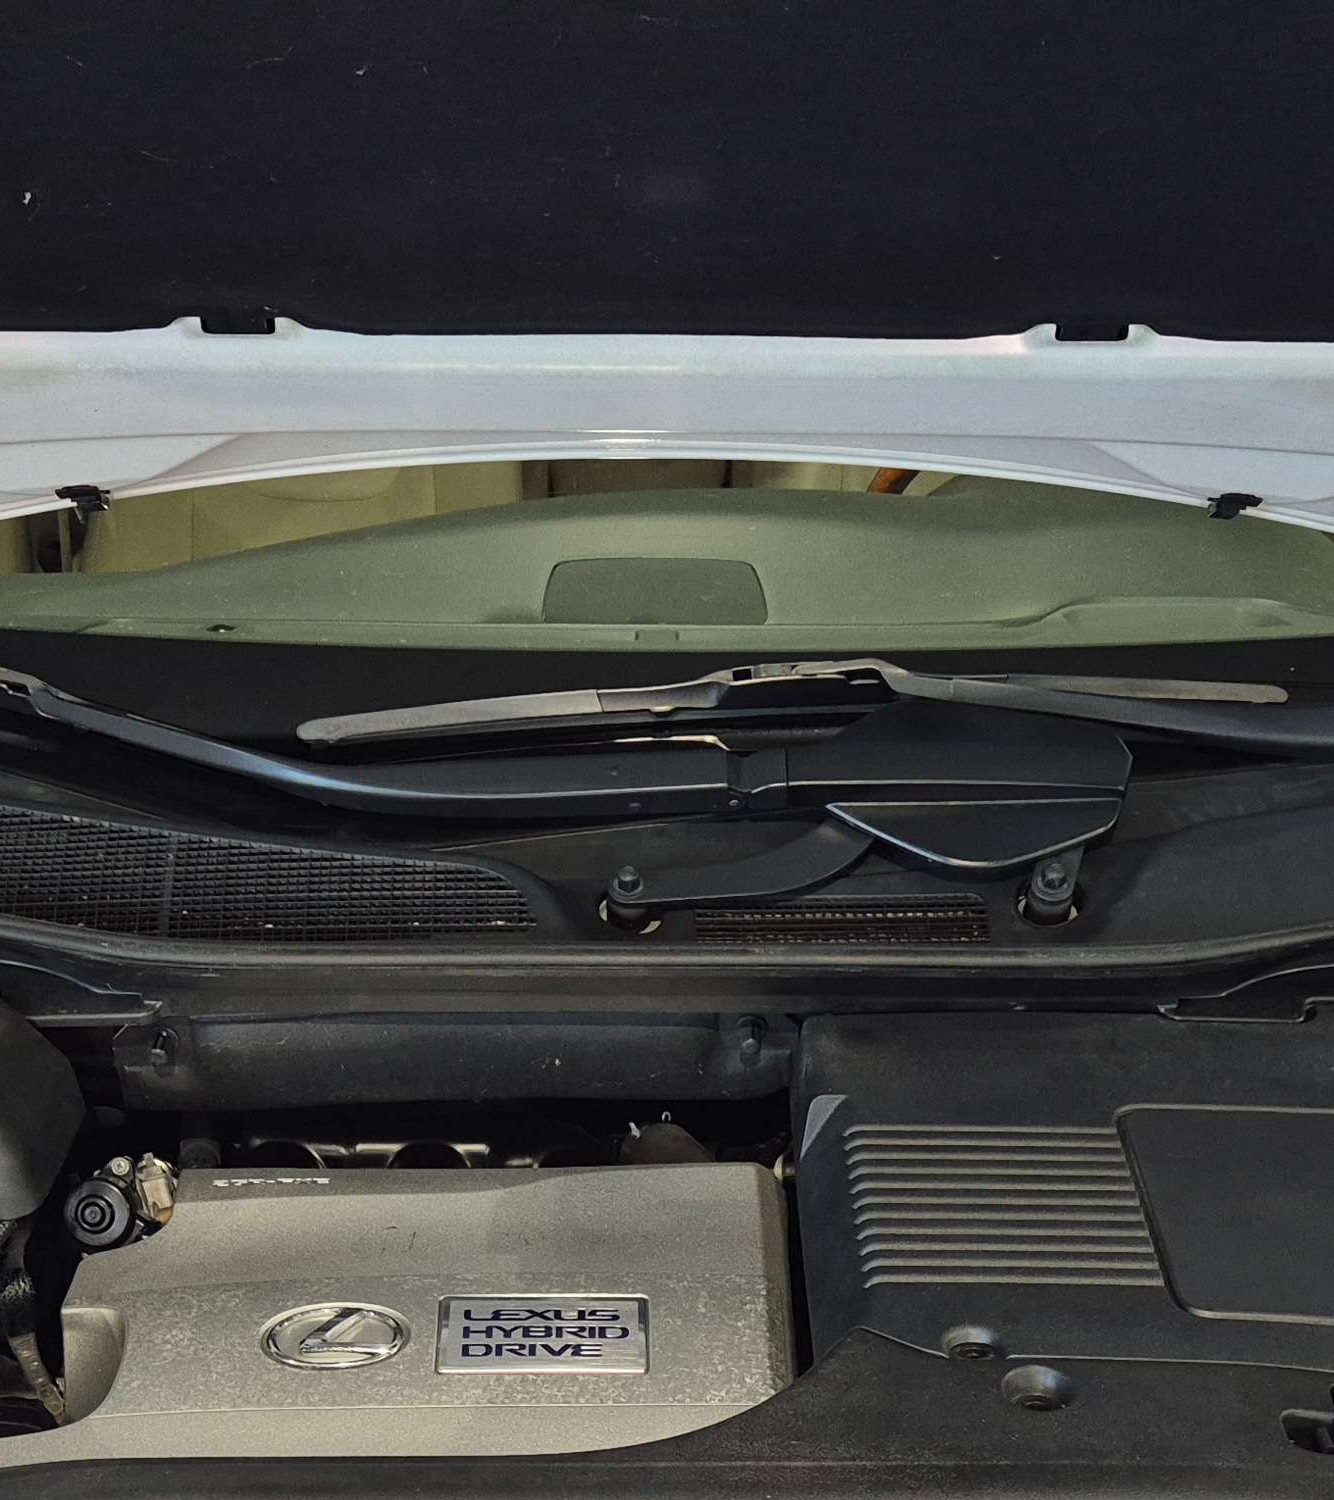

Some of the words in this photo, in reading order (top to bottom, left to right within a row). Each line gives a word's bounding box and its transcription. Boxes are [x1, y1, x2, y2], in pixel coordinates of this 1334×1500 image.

[463, 1308, 621, 1322] LEXUS
[462, 1325, 630, 1340] HYBRID
[461, 1342, 604, 1358] DRIVE
